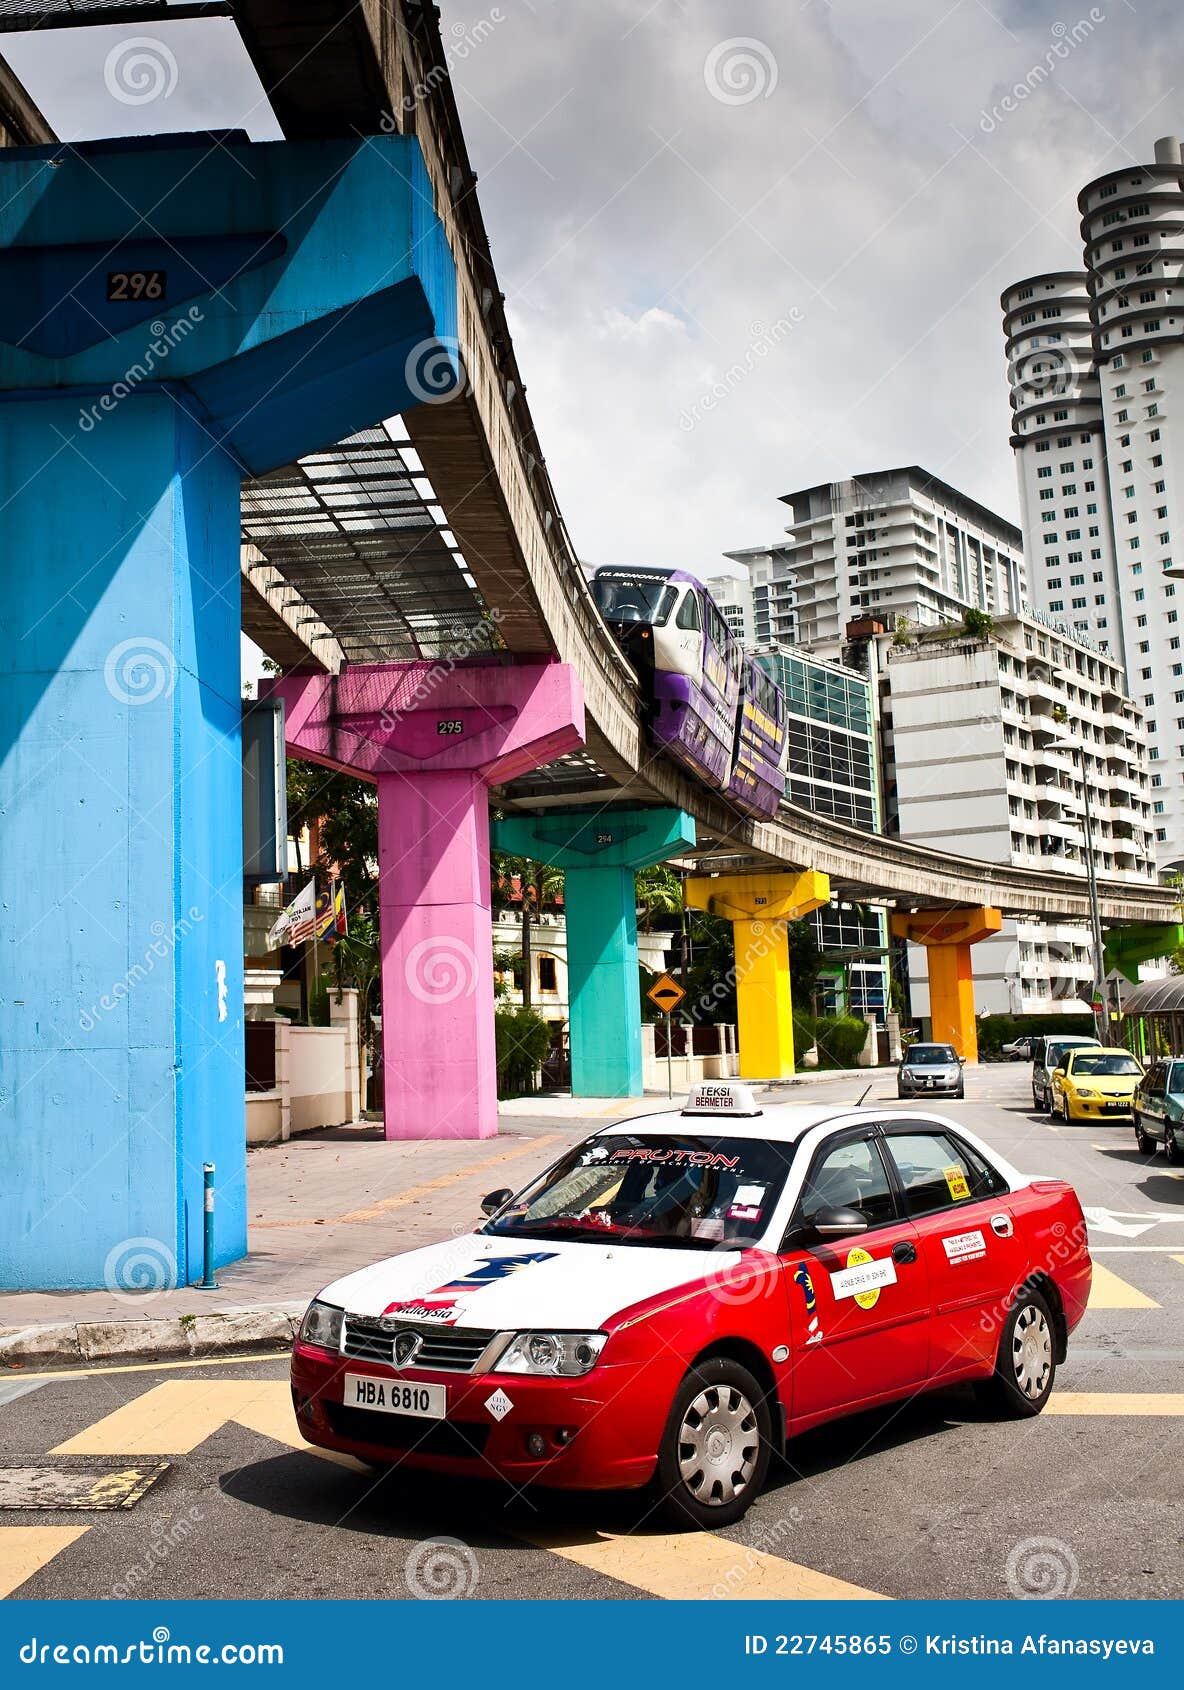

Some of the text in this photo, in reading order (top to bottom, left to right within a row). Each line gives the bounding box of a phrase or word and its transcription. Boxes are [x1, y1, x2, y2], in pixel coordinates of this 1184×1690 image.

[110, 274, 163, 300] 296
[613, 572, 669, 583] MONORAIL
[439, 722, 462, 734] 295
[598, 835, 612, 843] 294
[701, 1087, 731, 1096] TEKSI
[696, 1097, 733, 1107] BERMETER
[609, 1148, 740, 1168] PROTON
[660, 1160, 745, 1175] ACHIEVEMENT
[356, 1380, 430, 1411] HBA 6810
[490, 1403, 508, 1412] NGV
